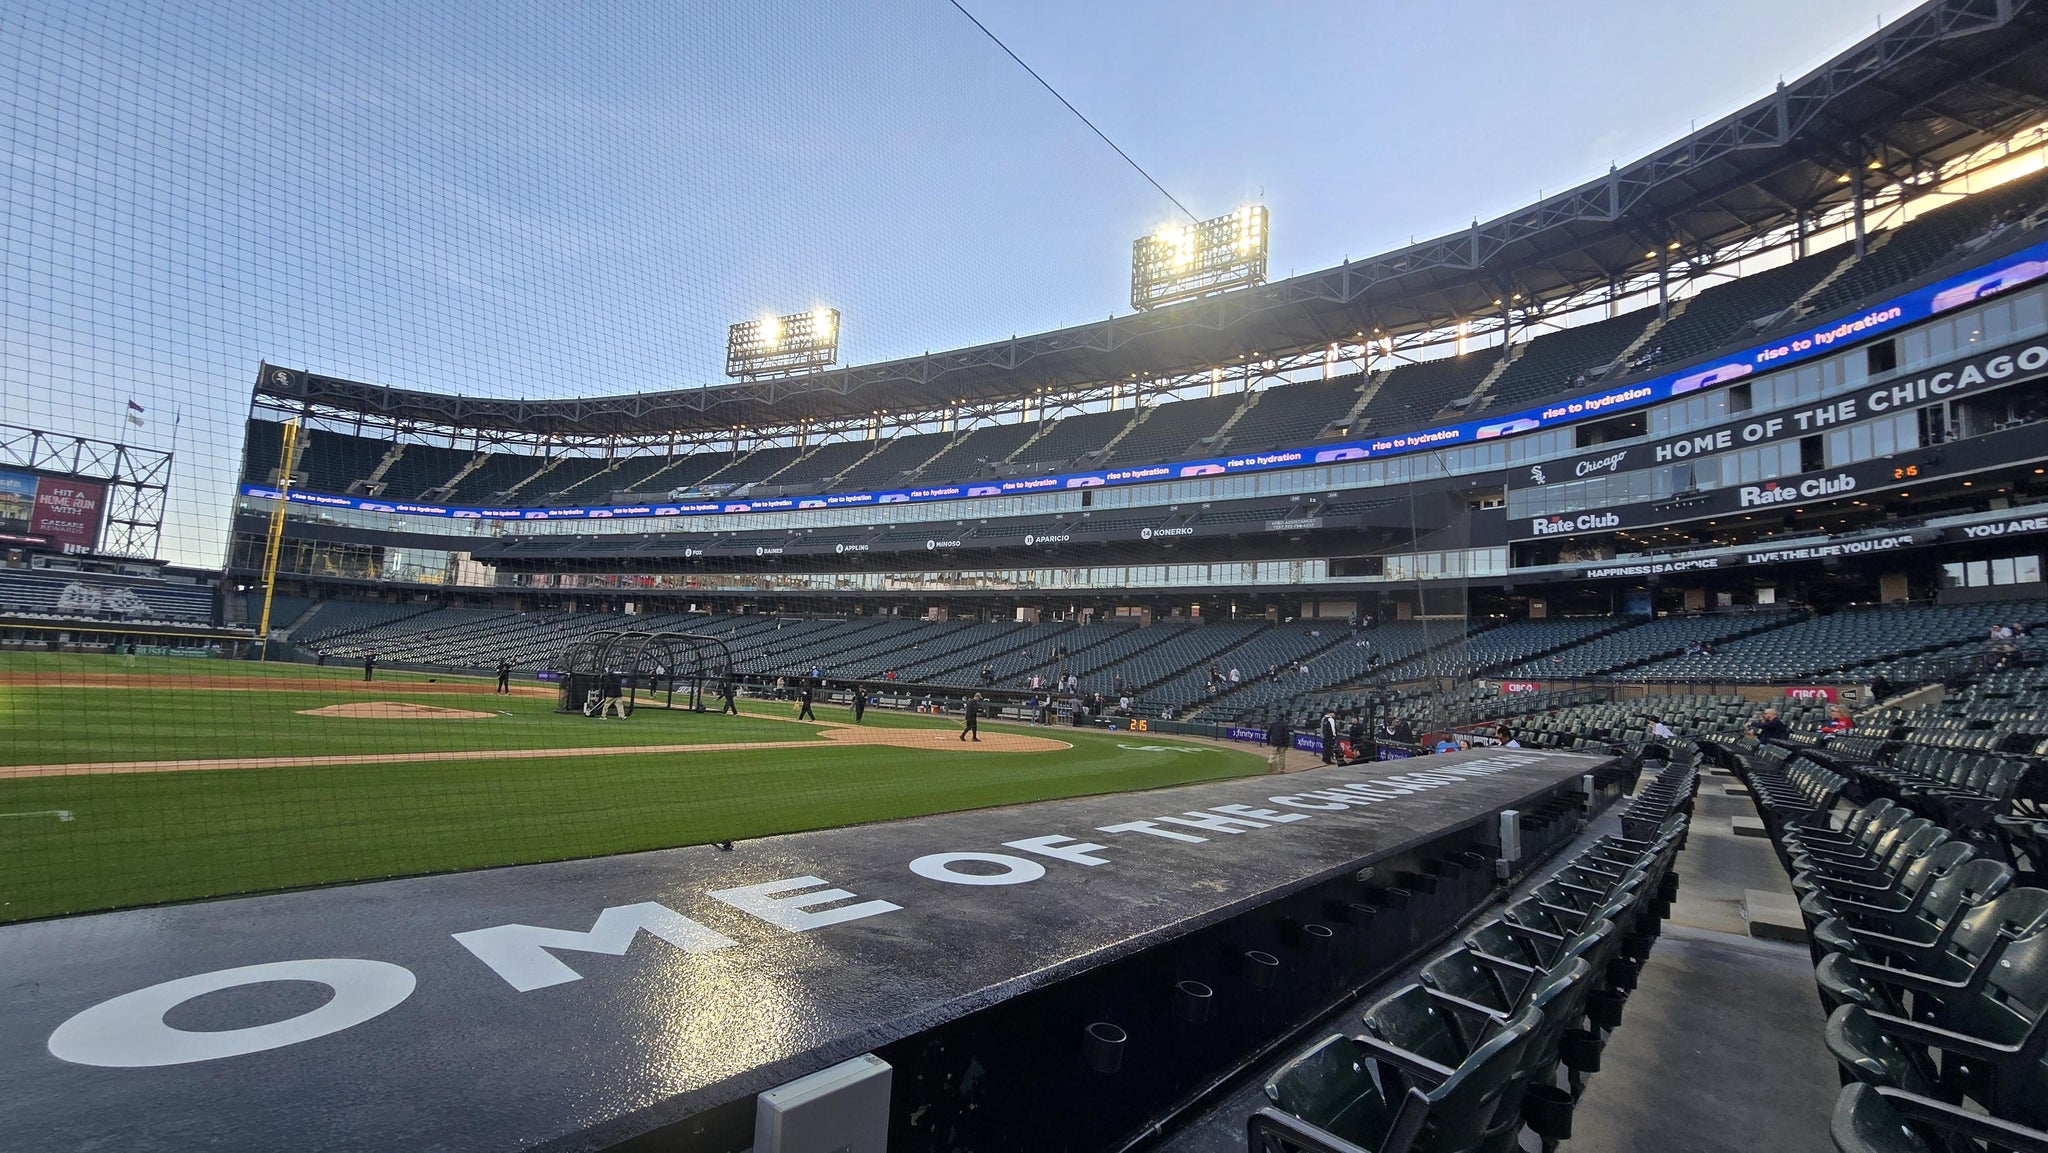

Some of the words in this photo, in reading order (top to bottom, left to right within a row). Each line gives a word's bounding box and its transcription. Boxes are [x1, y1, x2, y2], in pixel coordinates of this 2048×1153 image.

[1757, 346, 1789, 362] rise
[1792, 339, 1812, 352] to
[1814, 306, 1902, 344] hydration
[1542, 407, 1567, 419] rise
[1568, 403, 1583, 413] to
[1585, 387, 1652, 410] hydration
[1655, 429, 1733, 462] HOME
[1742, 418, 1783, 442] OF
[1793, 399, 1857, 430] THE
[1868, 346, 2048, 412] CHICAGO
[1372, 440, 1392, 451] rise
[1393, 438, 1405, 448] to
[1407, 429, 1460, 446] hydration
[1227, 459, 1245, 468] rise
[1245, 457, 1256, 466] to
[1257, 452, 1301, 465] hydration
[1575, 450, 1627, 476] Chicago
[1106, 472, 1122, 480] rise
[1122, 471, 1131, 479] to
[1131, 467, 1170, 479] hydration
[1002, 482, 1016, 490] rise
[1016, 481, 1024, 489] to
[1024, 478, 1058, 489] hydration
[1740, 483, 1797, 507] Rate
[1800, 473, 1856, 497] Club
[53, 488, 74, 497] HIT
[75, 491, 85, 499] A
[930, 487, 960, 497] hydration
[73, 498, 95, 510] RUN
[1533, 517, 1575, 535] Rate
[1576, 512, 1620, 530] Club
[1963, 523, 2005, 538] YOU
[2006, 517, 2048, 533] ARE
[1035, 534, 1070, 543] APARICIO
[1153, 527, 1193, 537] KONERKO
[62, 542, 90, 555] Lite
[844, 544, 869, 552] APPLING
[1748, 551, 1779, 564] LIVE
[1780, 548, 1810, 560] THE
[1810, 545, 1841, 558] LIFE
[1840, 540, 1873, 554] YOU
[1587, 565, 1651, 578] HAPPINESS
[1652, 564, 1663, 573] IS
[1664, 563, 1673, 572] A
[1297, 737, 1315, 748] xfinity
[909, 834, 1111, 886] OF
[1096, 803, 1312, 843] THE
[1268, 772, 1467, 811] CHICAGO
